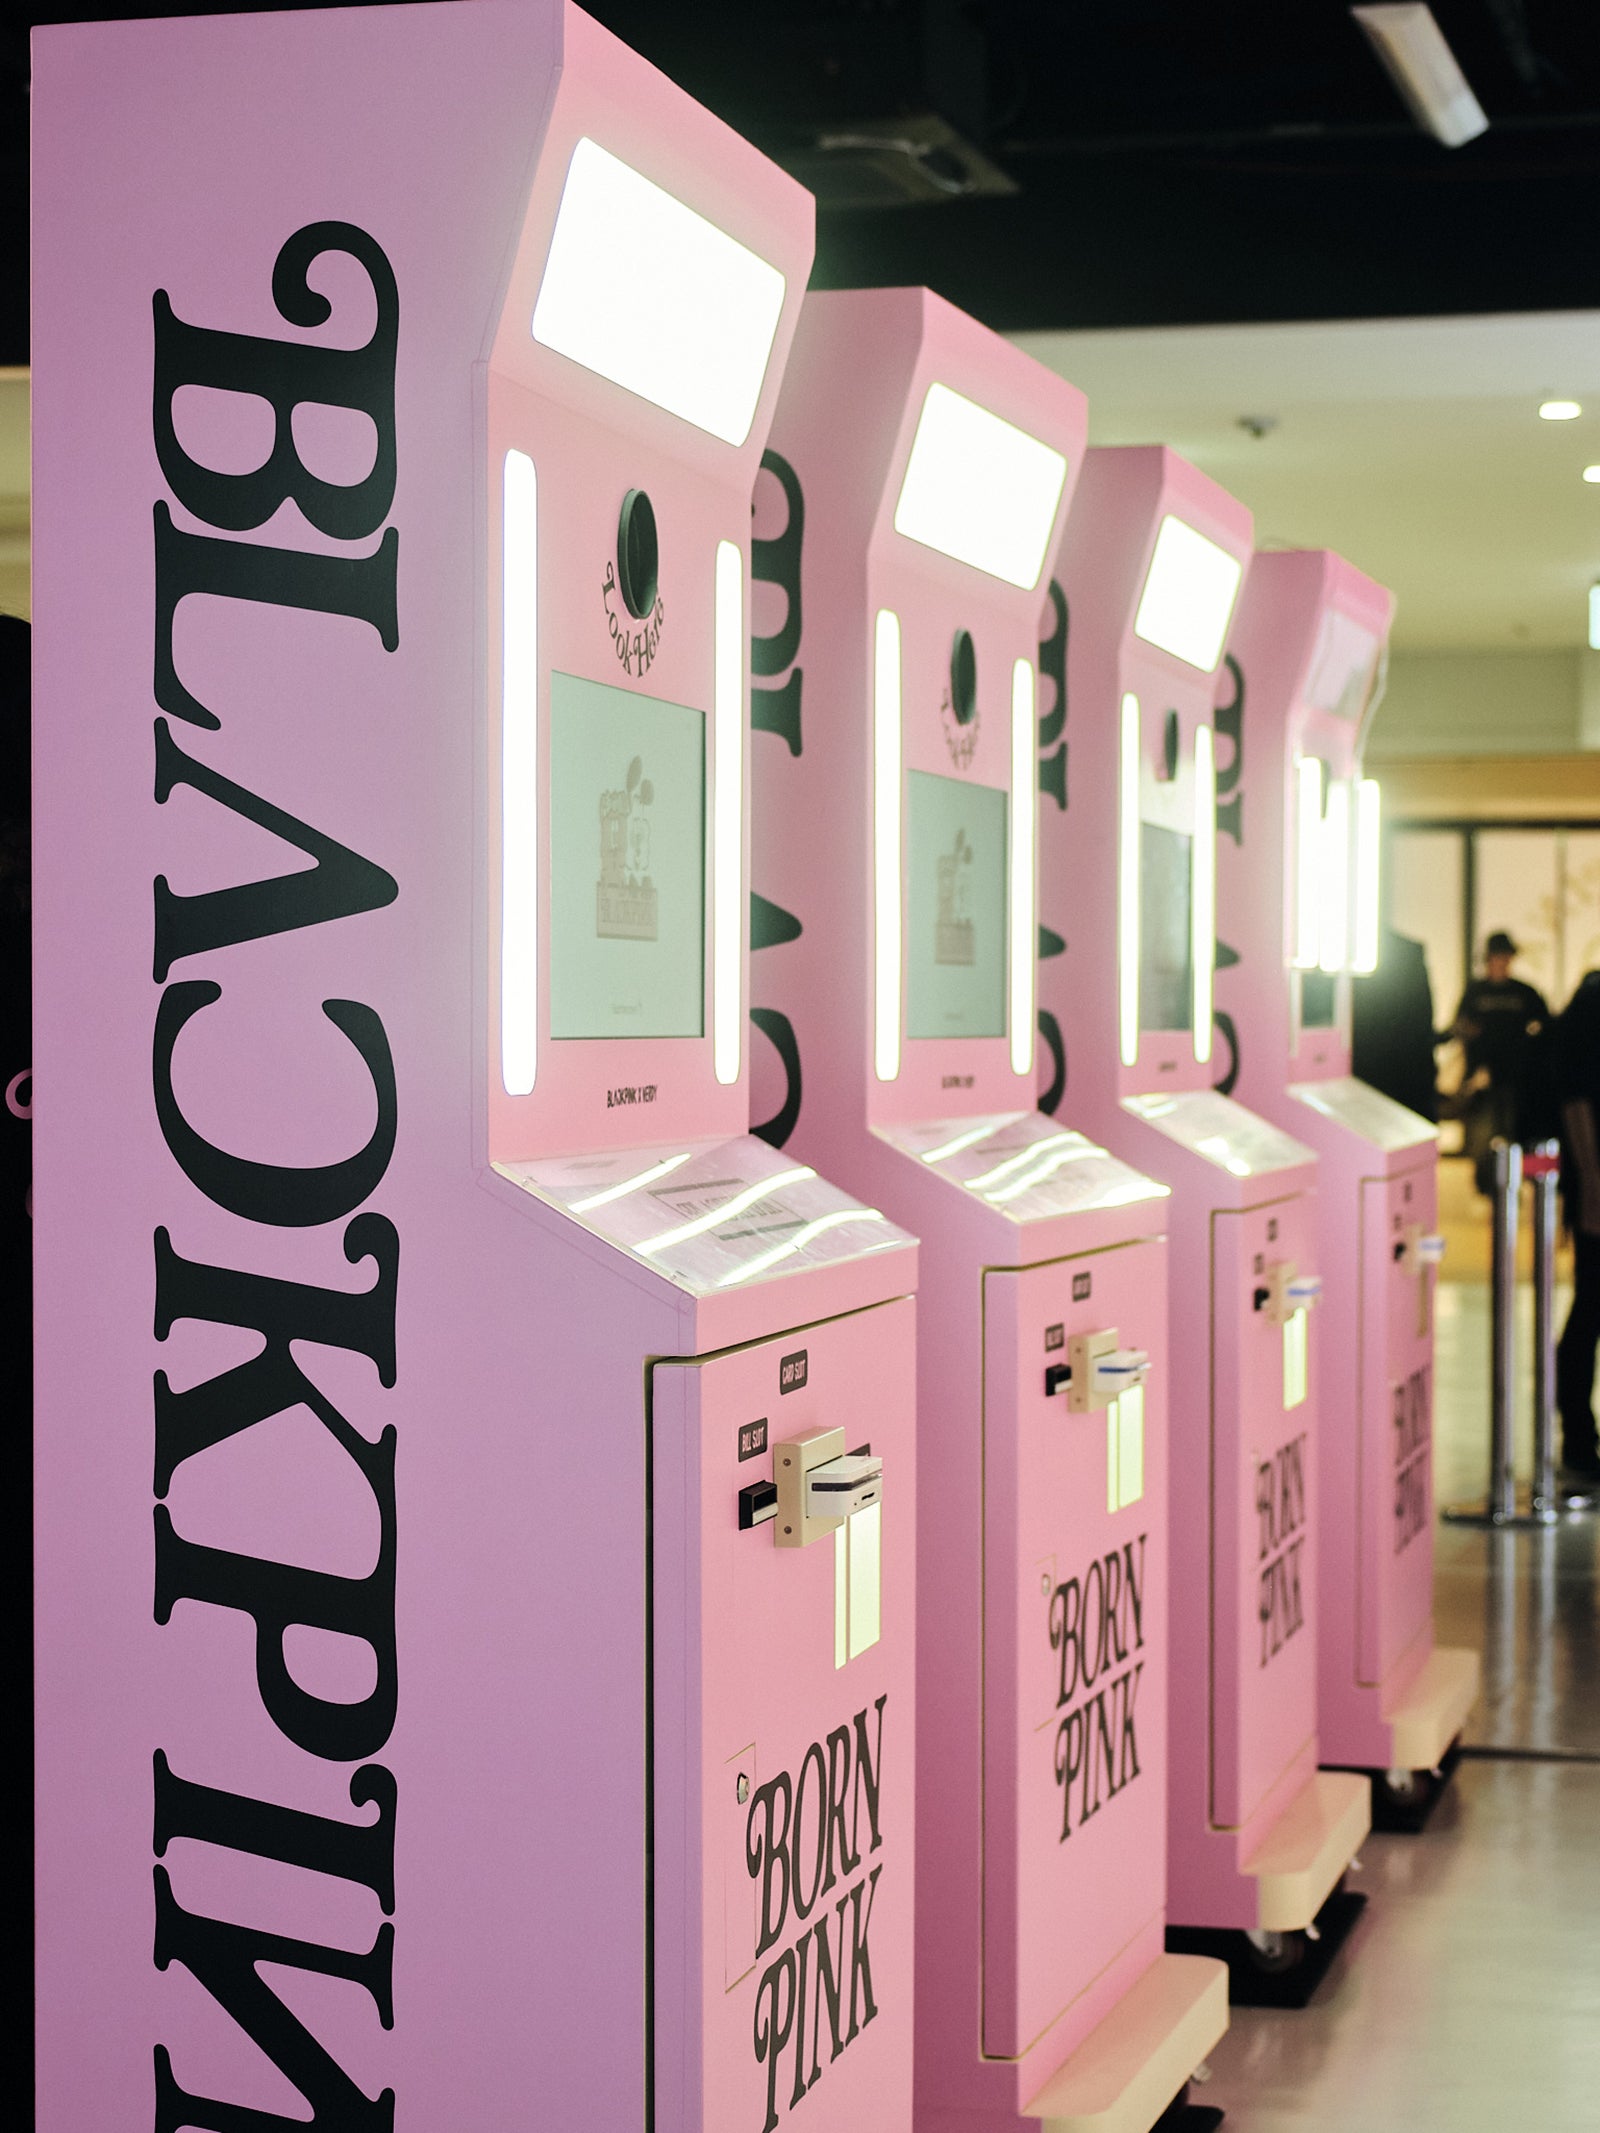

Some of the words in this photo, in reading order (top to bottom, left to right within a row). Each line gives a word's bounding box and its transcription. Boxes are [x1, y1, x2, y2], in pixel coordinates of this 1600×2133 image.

[602, 560, 633, 676] Look
[742, 1433, 753, 1453] BILL
[752, 1426, 765, 1449] SLOT
[782, 1363, 795, 1385] CARD
[794, 1359, 806, 1381] SLOT
[1049, 1532, 1147, 1710] BORN
[746, 1693, 888, 1960] BORN
[1054, 1660, 1144, 1845] PINK
[753, 1862, 883, 2133] PINK
